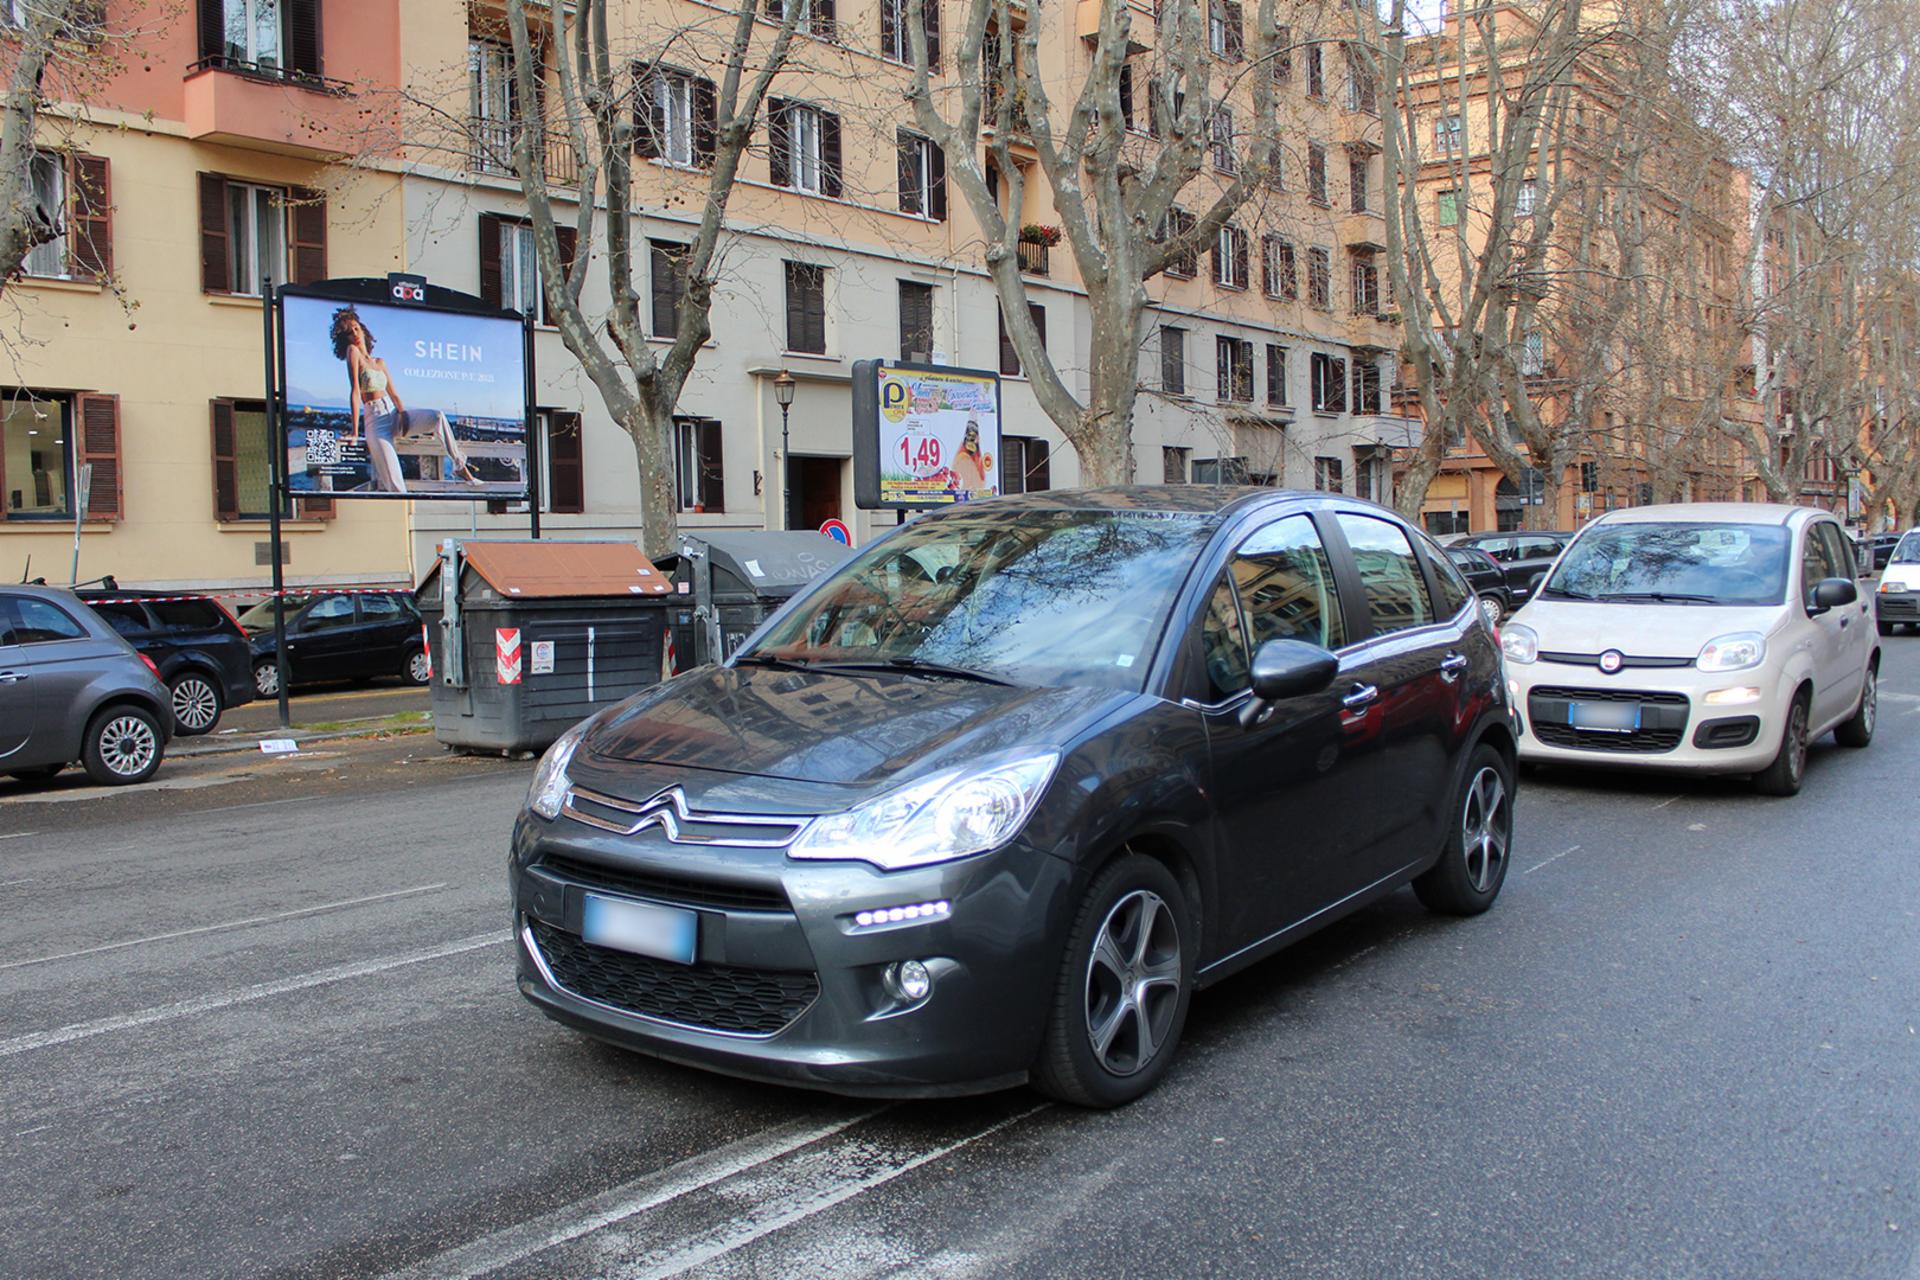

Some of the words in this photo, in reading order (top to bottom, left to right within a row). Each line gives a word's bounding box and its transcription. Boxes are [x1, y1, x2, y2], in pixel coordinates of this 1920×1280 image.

[393, 286, 424, 301] apa
[415, 340, 482, 363] SHEIN
[901, 436, 940, 473] 1,49
